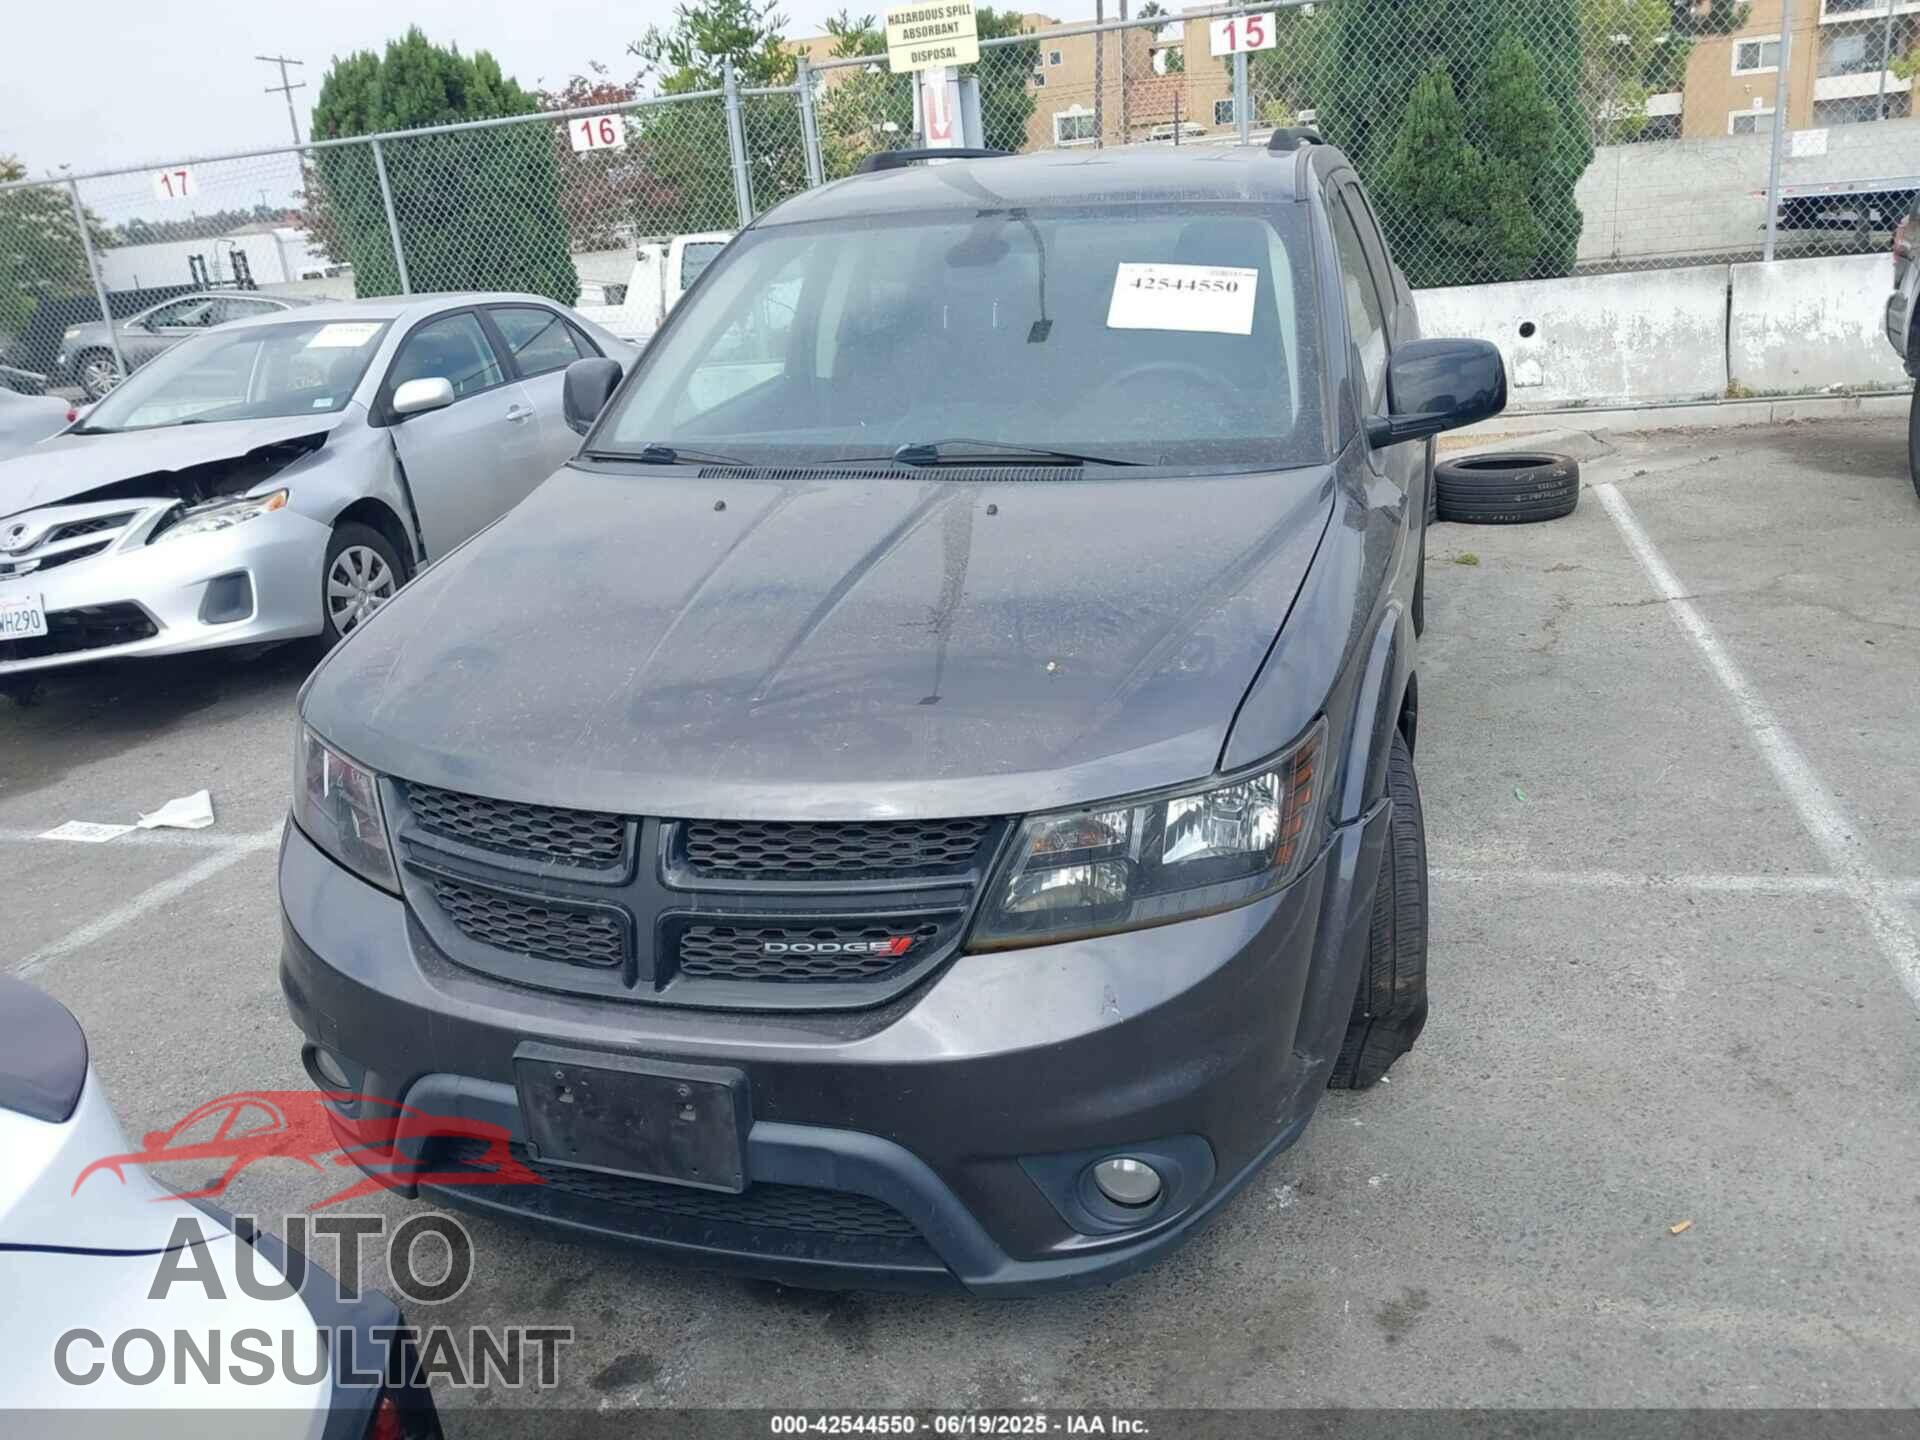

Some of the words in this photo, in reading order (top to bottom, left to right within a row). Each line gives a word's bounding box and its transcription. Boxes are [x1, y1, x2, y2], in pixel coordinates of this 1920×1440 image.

[888, 7, 944, 25] HAZARDOUS
[946, 3, 971, 18] SPILL
[903, 21, 959, 40] ABSORBANT
[1223, 16, 1264, 50] 15
[911, 46, 957, 63] DISPOSAL
[580, 118, 616, 147] 16
[160, 171, 188, 198] 17
[1129, 277, 1238, 293] 42544550
[763, 941, 894, 953] DODGE
